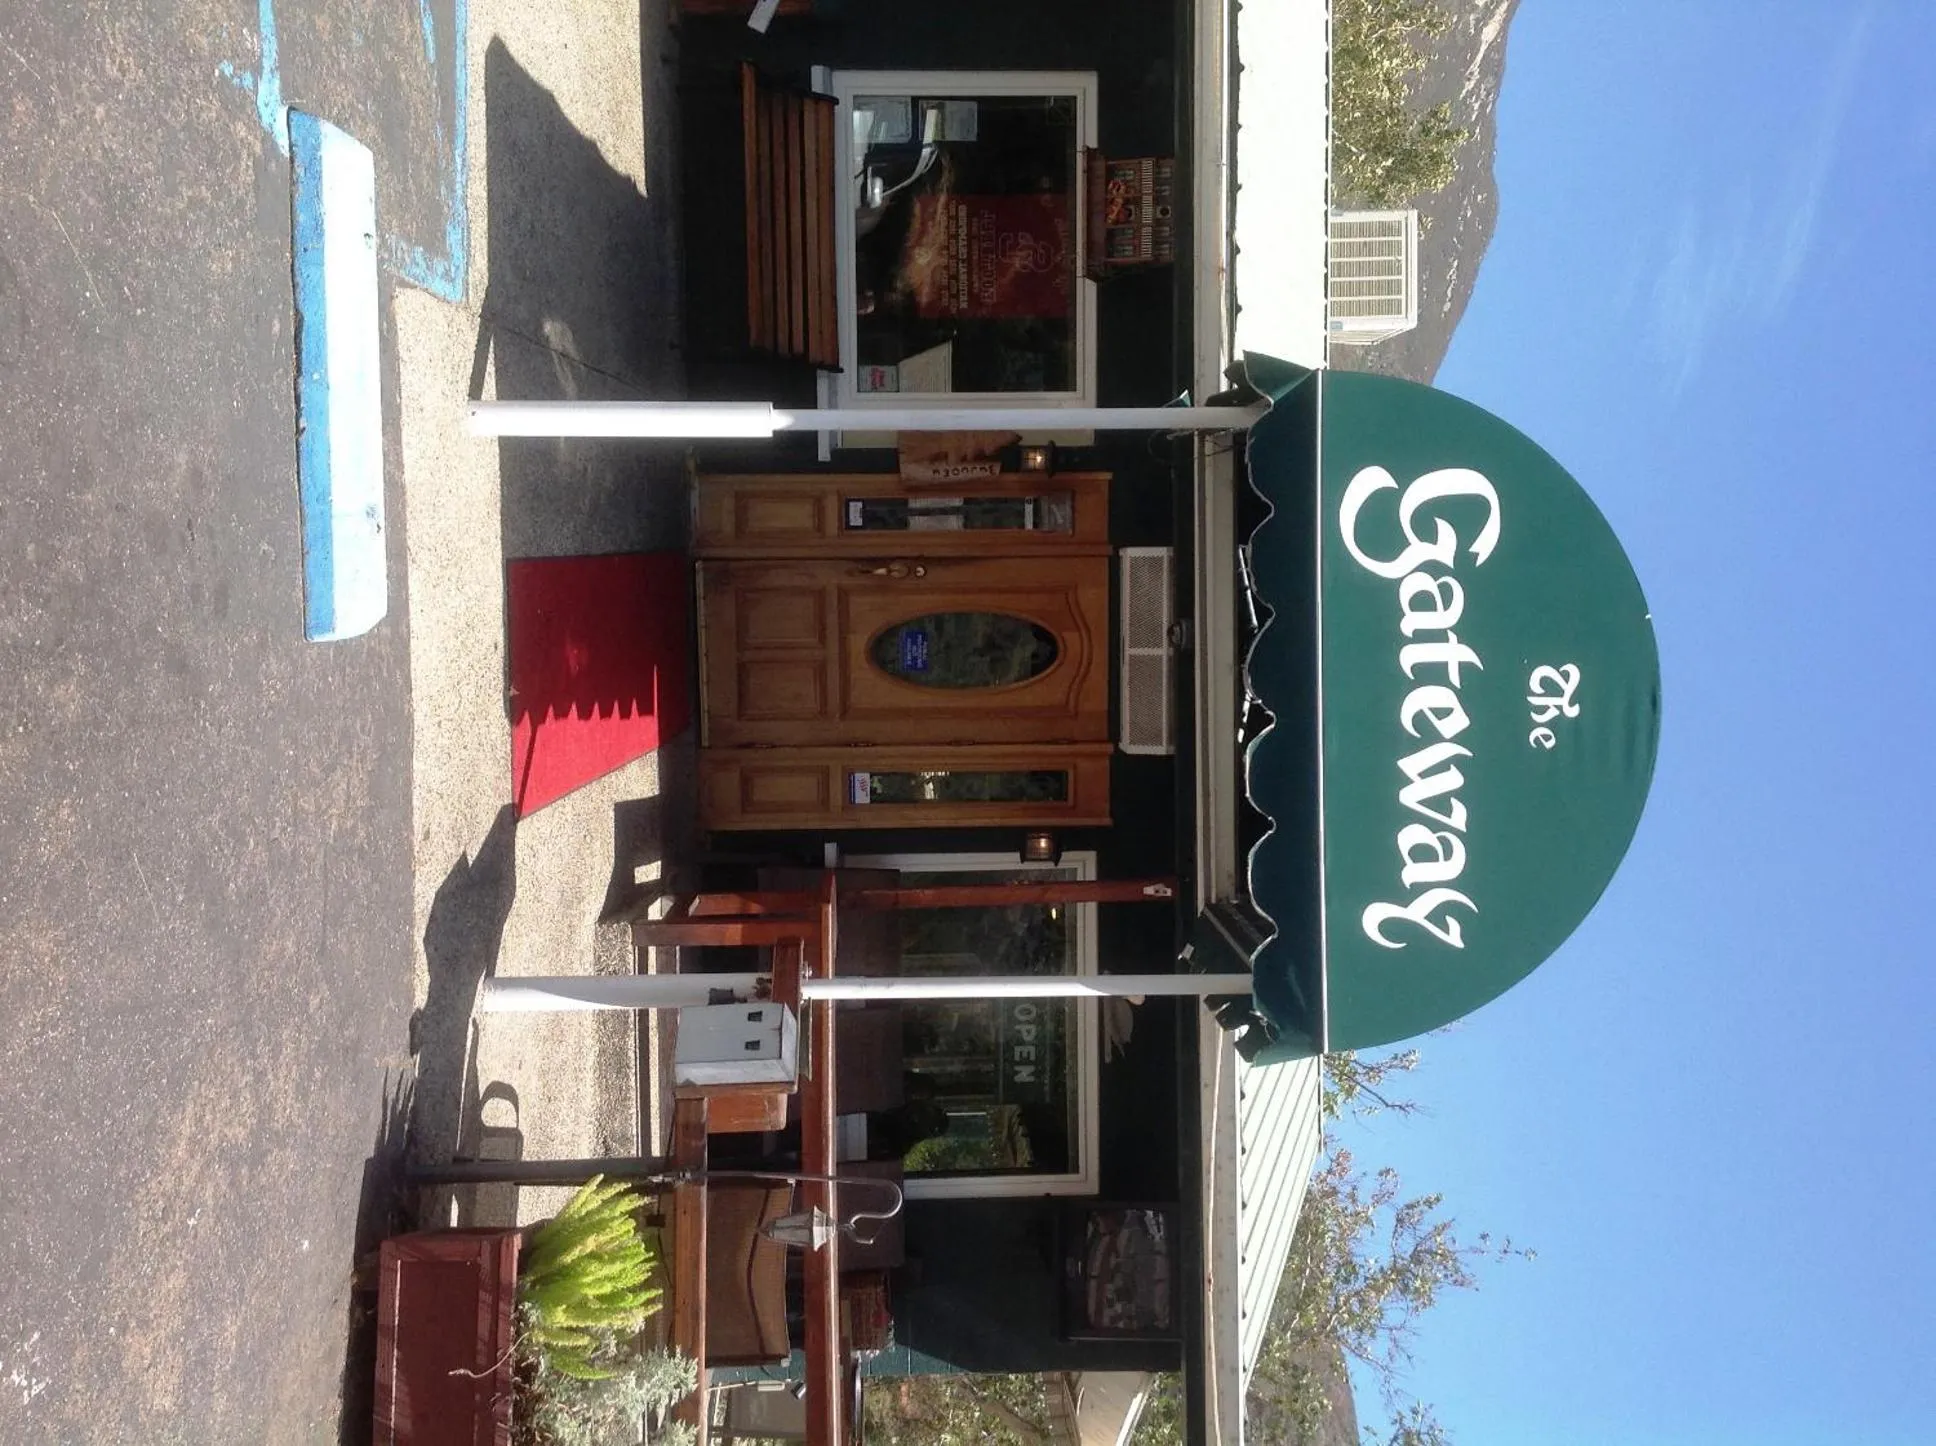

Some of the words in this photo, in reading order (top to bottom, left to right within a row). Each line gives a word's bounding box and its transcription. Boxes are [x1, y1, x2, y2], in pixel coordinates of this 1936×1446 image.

[932, 463, 997, 479] WELCOME
[1339, 466, 1500, 948] Gateway
[1527, 664, 1580, 749] The
[1012, 1003, 1036, 1083] OPEN
